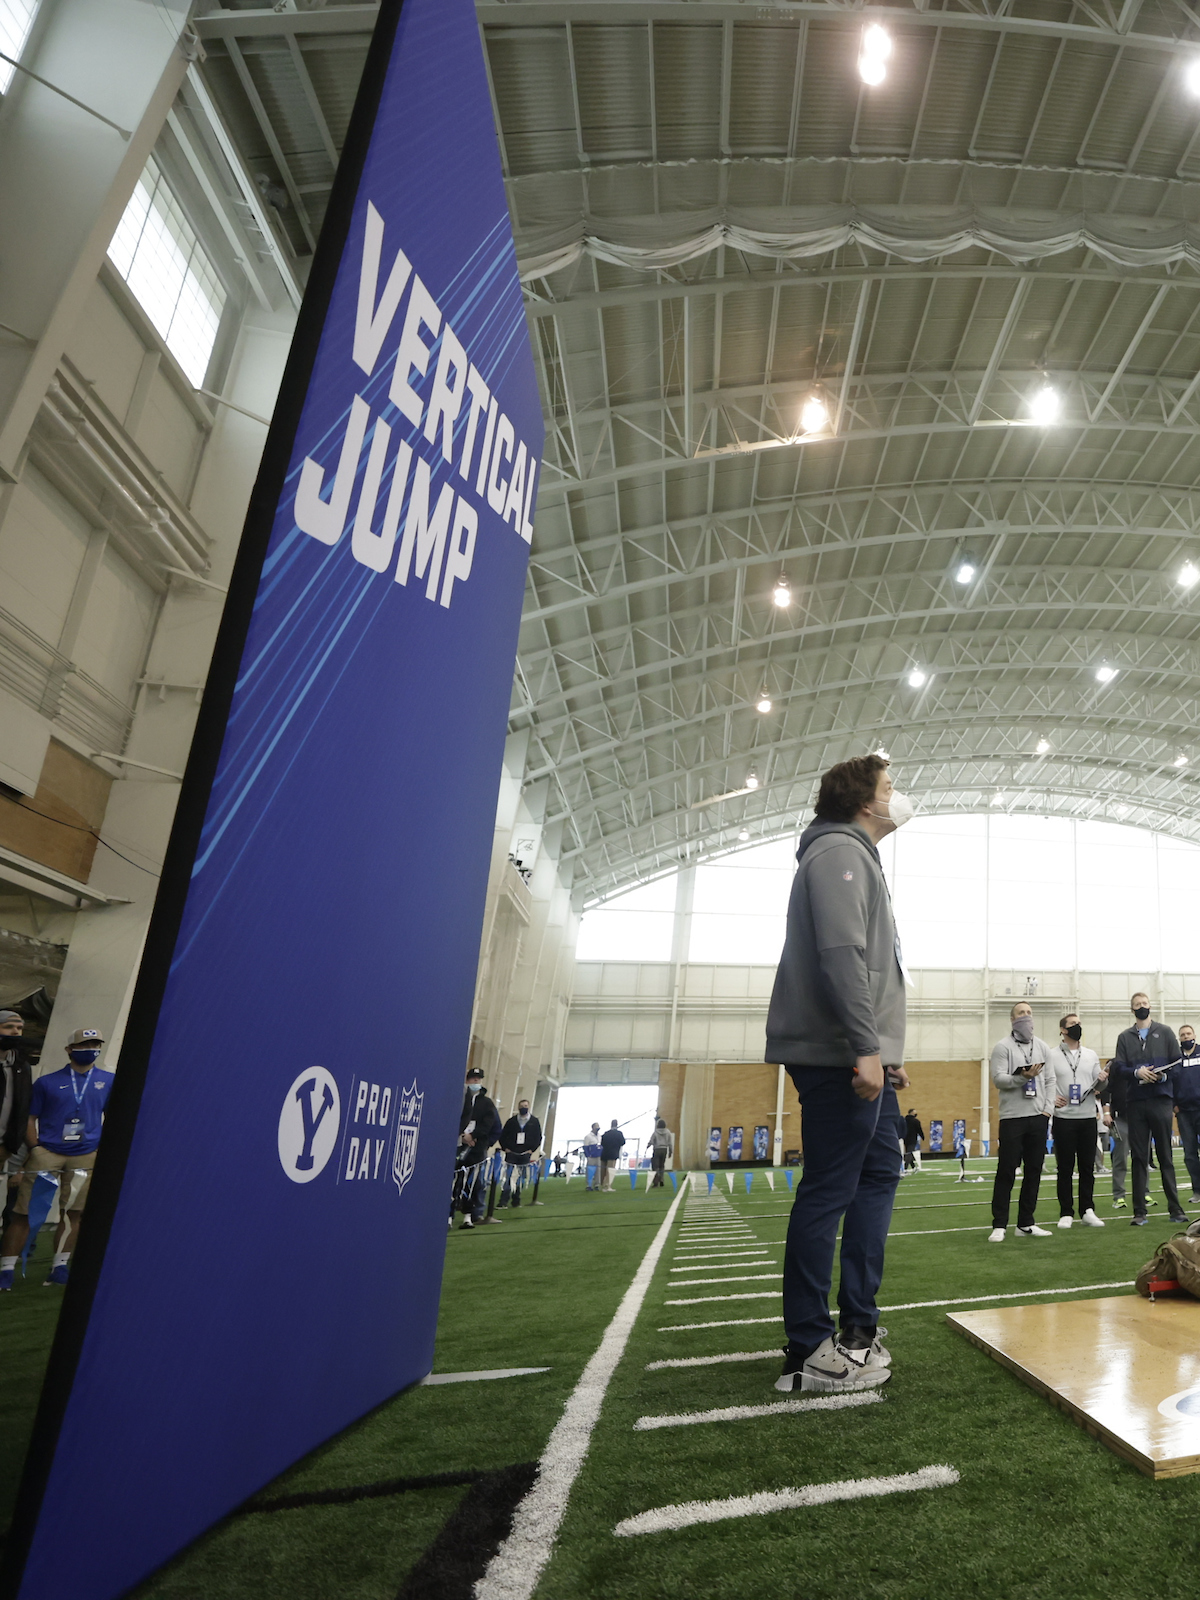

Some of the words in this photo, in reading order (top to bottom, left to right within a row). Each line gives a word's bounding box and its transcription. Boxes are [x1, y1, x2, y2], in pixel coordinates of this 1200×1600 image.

[352, 199, 537, 546] VERTICAL
[294, 393, 479, 609] JUMP
[345, 1137, 385, 1180] DAY
[354, 1080, 392, 1126] PRO
